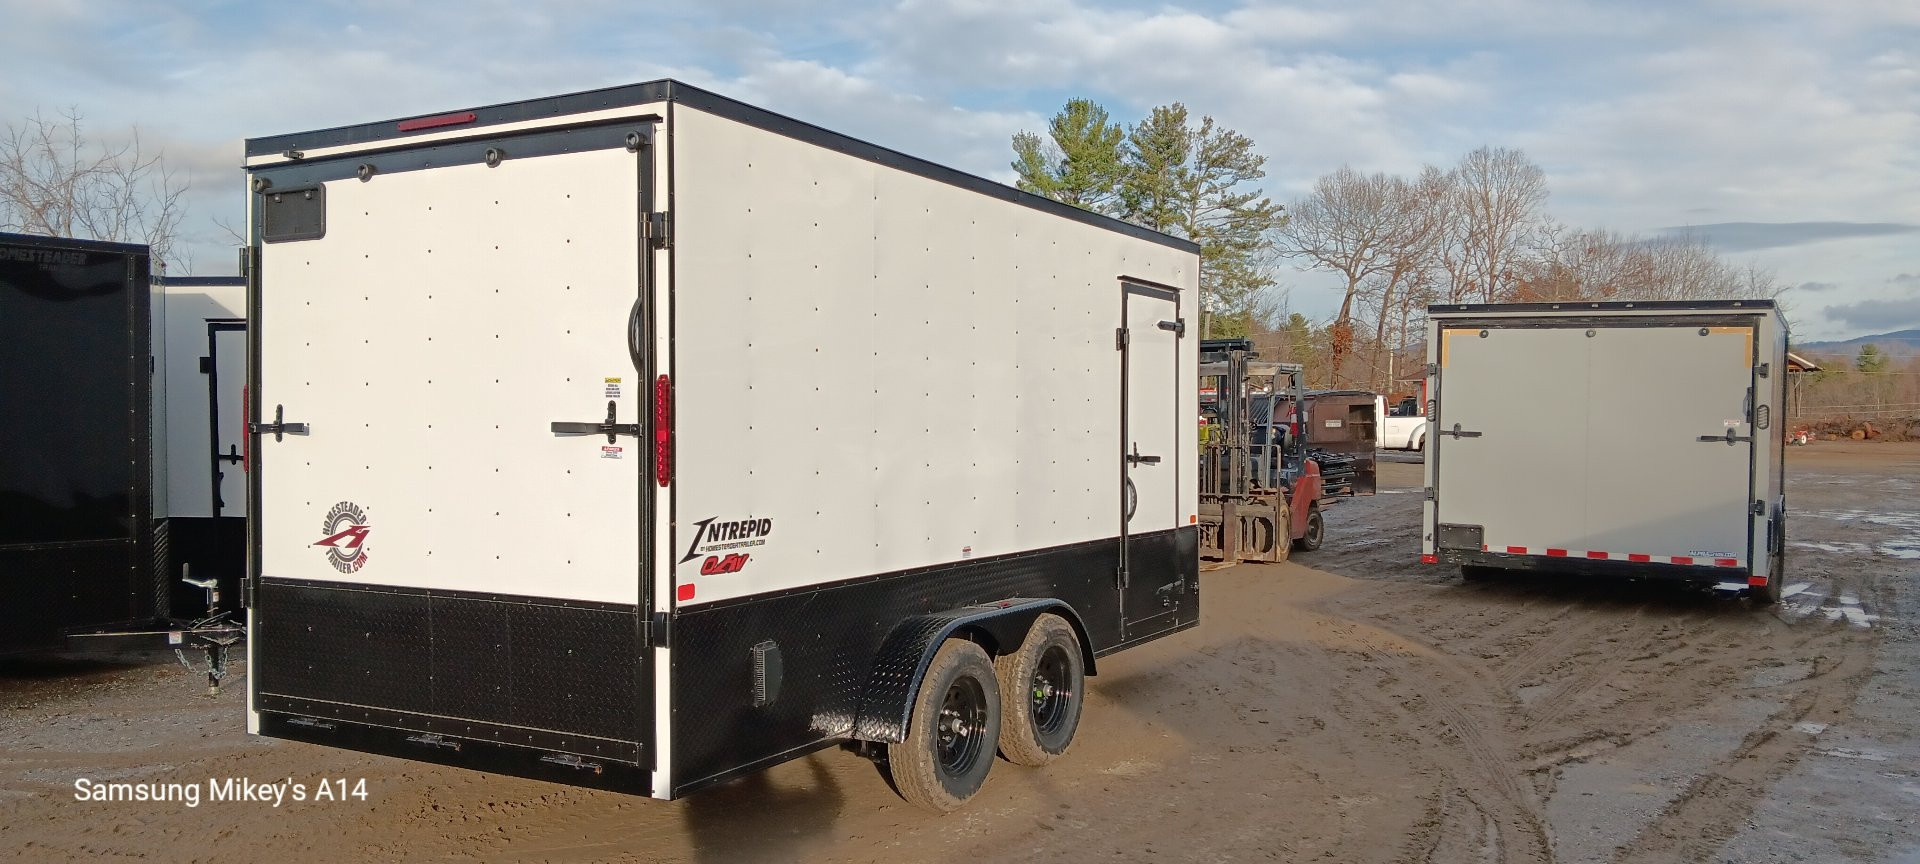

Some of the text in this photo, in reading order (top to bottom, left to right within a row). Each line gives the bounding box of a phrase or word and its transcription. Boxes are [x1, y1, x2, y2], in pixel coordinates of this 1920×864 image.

[0, 247, 87, 265] OMESTEADER
[322, 501, 367, 536] HOMESTEADER
[678, 516, 772, 564] INTREPID
[326, 547, 368, 574] TRAILER.COM
